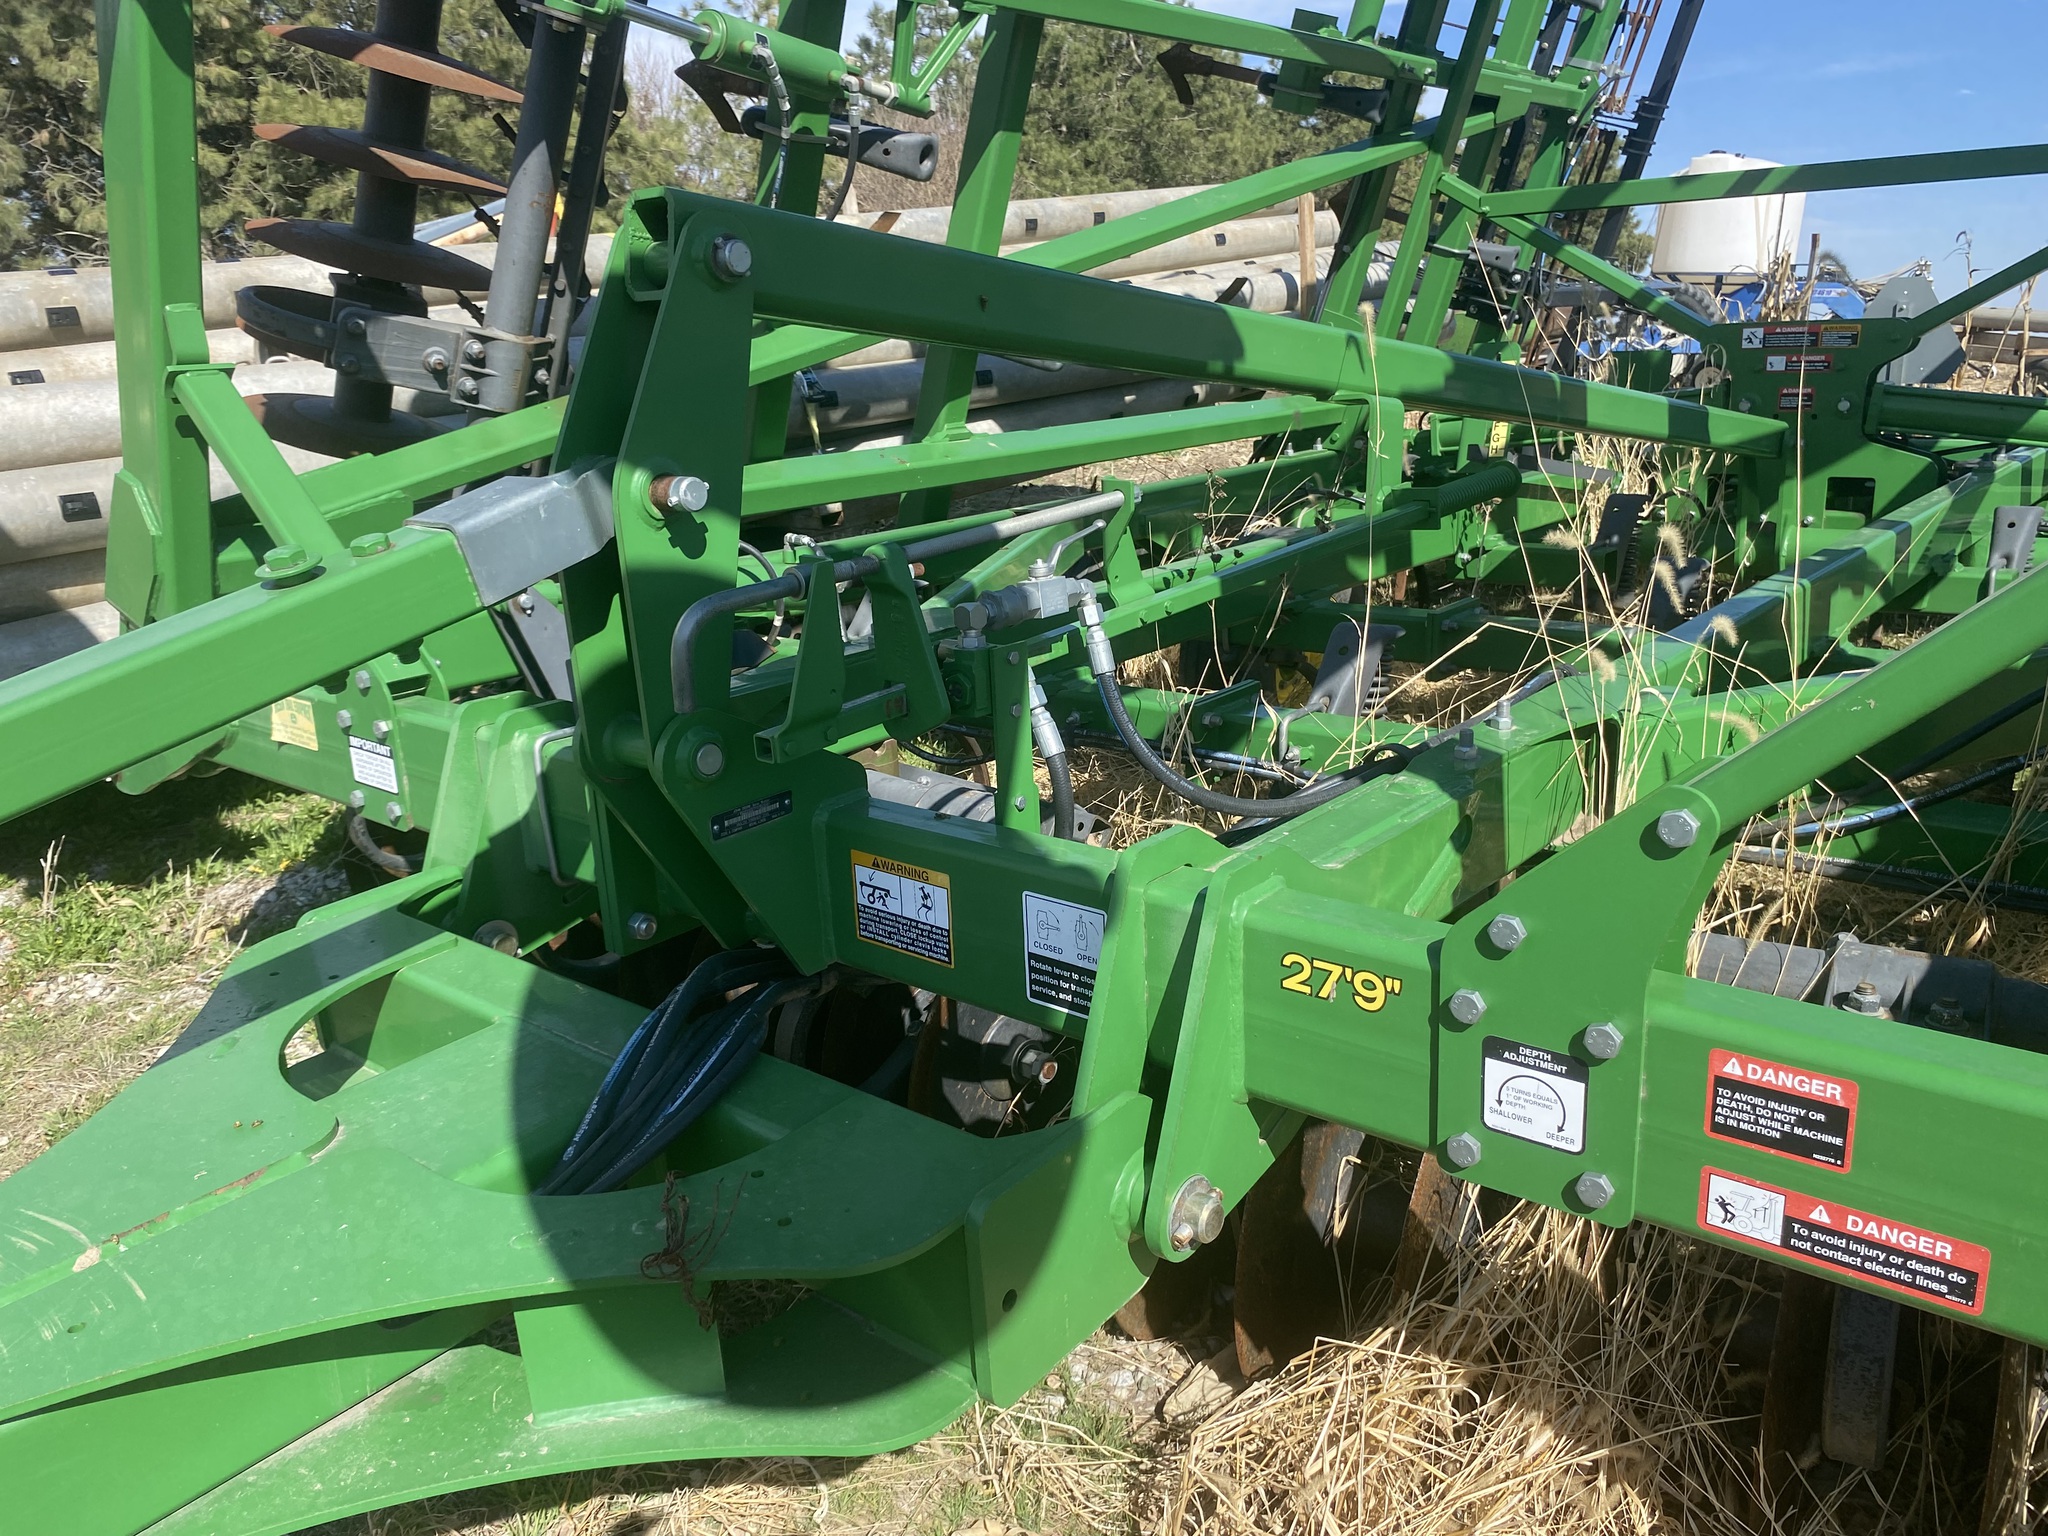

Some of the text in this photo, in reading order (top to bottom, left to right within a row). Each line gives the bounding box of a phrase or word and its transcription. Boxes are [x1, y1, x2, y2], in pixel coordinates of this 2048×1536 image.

[1492, 433, 1500, 443] G
[1494, 421, 1501, 431] F
[1491, 445, 1499, 454] H
[349, 736, 391, 757] IMPORTANT
[880, 859, 930, 882] WARNING
[859, 912, 880, 922] machine
[881, 918, 902, 929] lowering
[910, 927, 922, 935] loss
[929, 932, 949, 942] control
[865, 907, 877, 915] avoid
[879, 911, 896, 921] serious
[896, 916, 910, 926] injury
[918, 923, 932, 931] death
[859, 918, 875, 928] during
[900, 930, 917, 939] CLOSE
[918, 935, 935, 945] lockup
[936, 940, 949, 949] valve
[860, 930, 874, 939] before
[875, 934, 902, 948] transporting
[908, 945, 929, 956] servicing
[866, 925, 889, 937] INSTALL
[890, 933, 913, 944] cylinder
[914, 939, 931, 950] clevis
[931, 945, 947, 955] locks
[1033, 940, 1098, 965] CLOSED OPEN
[1030, 959, 1095, 985] Rotate lever to clos
[1281, 952, 1402, 1012] 27'9"
[1031, 972, 1094, 997] position for transp
[1031, 984, 1091, 1008] service, and stora
[1503, 1051, 1568, 1074] ADJUSTMENT
[1519, 1046, 1552, 1062] DEPTH
[1747, 1063, 1842, 1100] DANGER
[1505, 1100, 1526, 1110] DEPTH
[1511, 1087, 1532, 1098] TURNS
[1532, 1093, 1559, 1105] EQUALS
[1523, 1097, 1554, 1111] WORKING
[1717, 1087, 1826, 1122] TO AVOID INJURY OR
[1489, 1106, 1533, 1125] SHALLOWER
[1716, 1097, 1797, 1124] DEATH, DO NOT
[1715, 1106, 1844, 1146] ADJUST WHILE MACHINE
[1715, 1115, 1781, 1139] IS IN MOTION
[1546, 1131, 1575, 1146] DEEPER
[1846, 1214, 1953, 1260] DANGER
[1790, 1237, 1949, 1294] not contact electric lines
[1791, 1222, 1967, 1285] To avoid injury or death do
